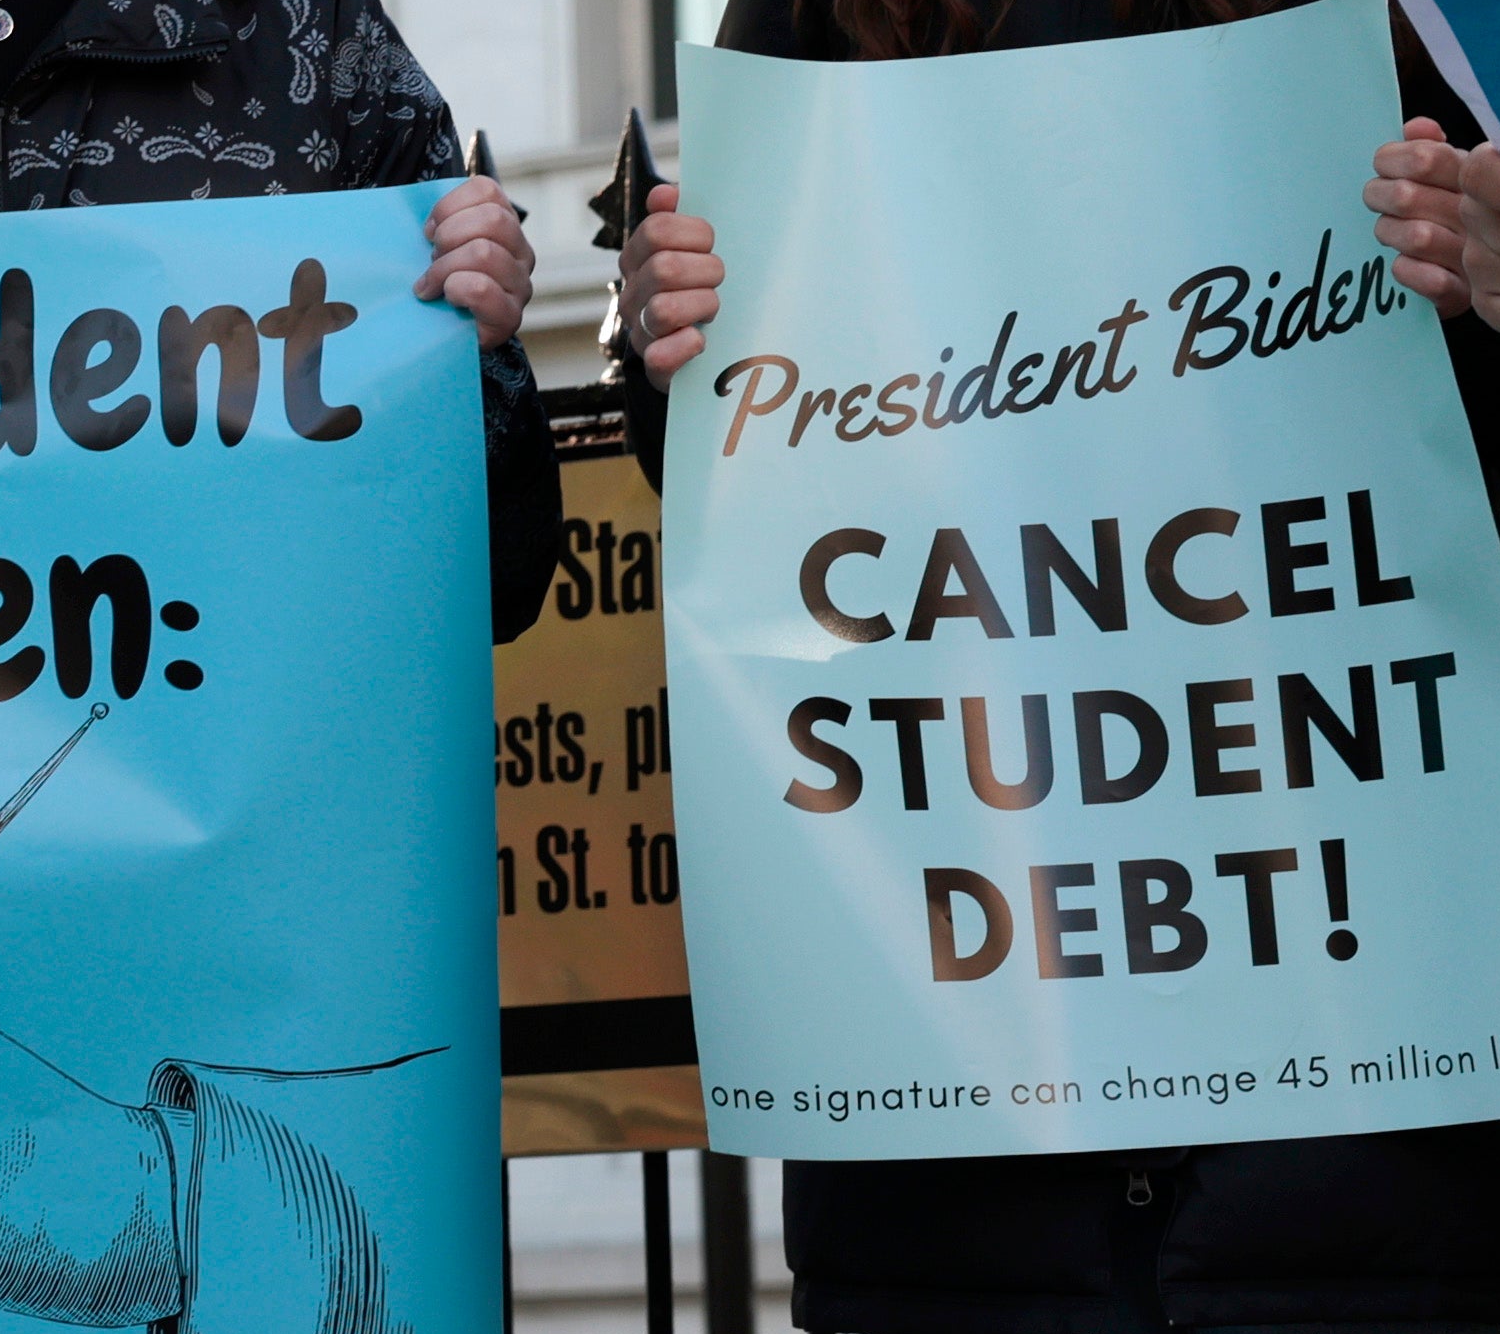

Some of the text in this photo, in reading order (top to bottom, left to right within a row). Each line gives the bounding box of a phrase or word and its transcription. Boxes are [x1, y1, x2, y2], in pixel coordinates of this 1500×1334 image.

[713, 297, 1150, 457] President
[556, 517, 662, 621] Sta
[798, 489, 1415, 645] CANCEL
[782, 651, 1458, 815] STUDENT
[535, 824, 608, 914] St.
[921, 837, 1359, 983] DEBT!
[710, 1082, 776, 1113] one
[792, 1080, 993, 1122] signature
[1010, 1078, 1083, 1107] can
[1101, 1066, 1258, 1106] change
[1276, 1056, 1331, 1090] 45
[1349, 1045, 1477, 1085] million
